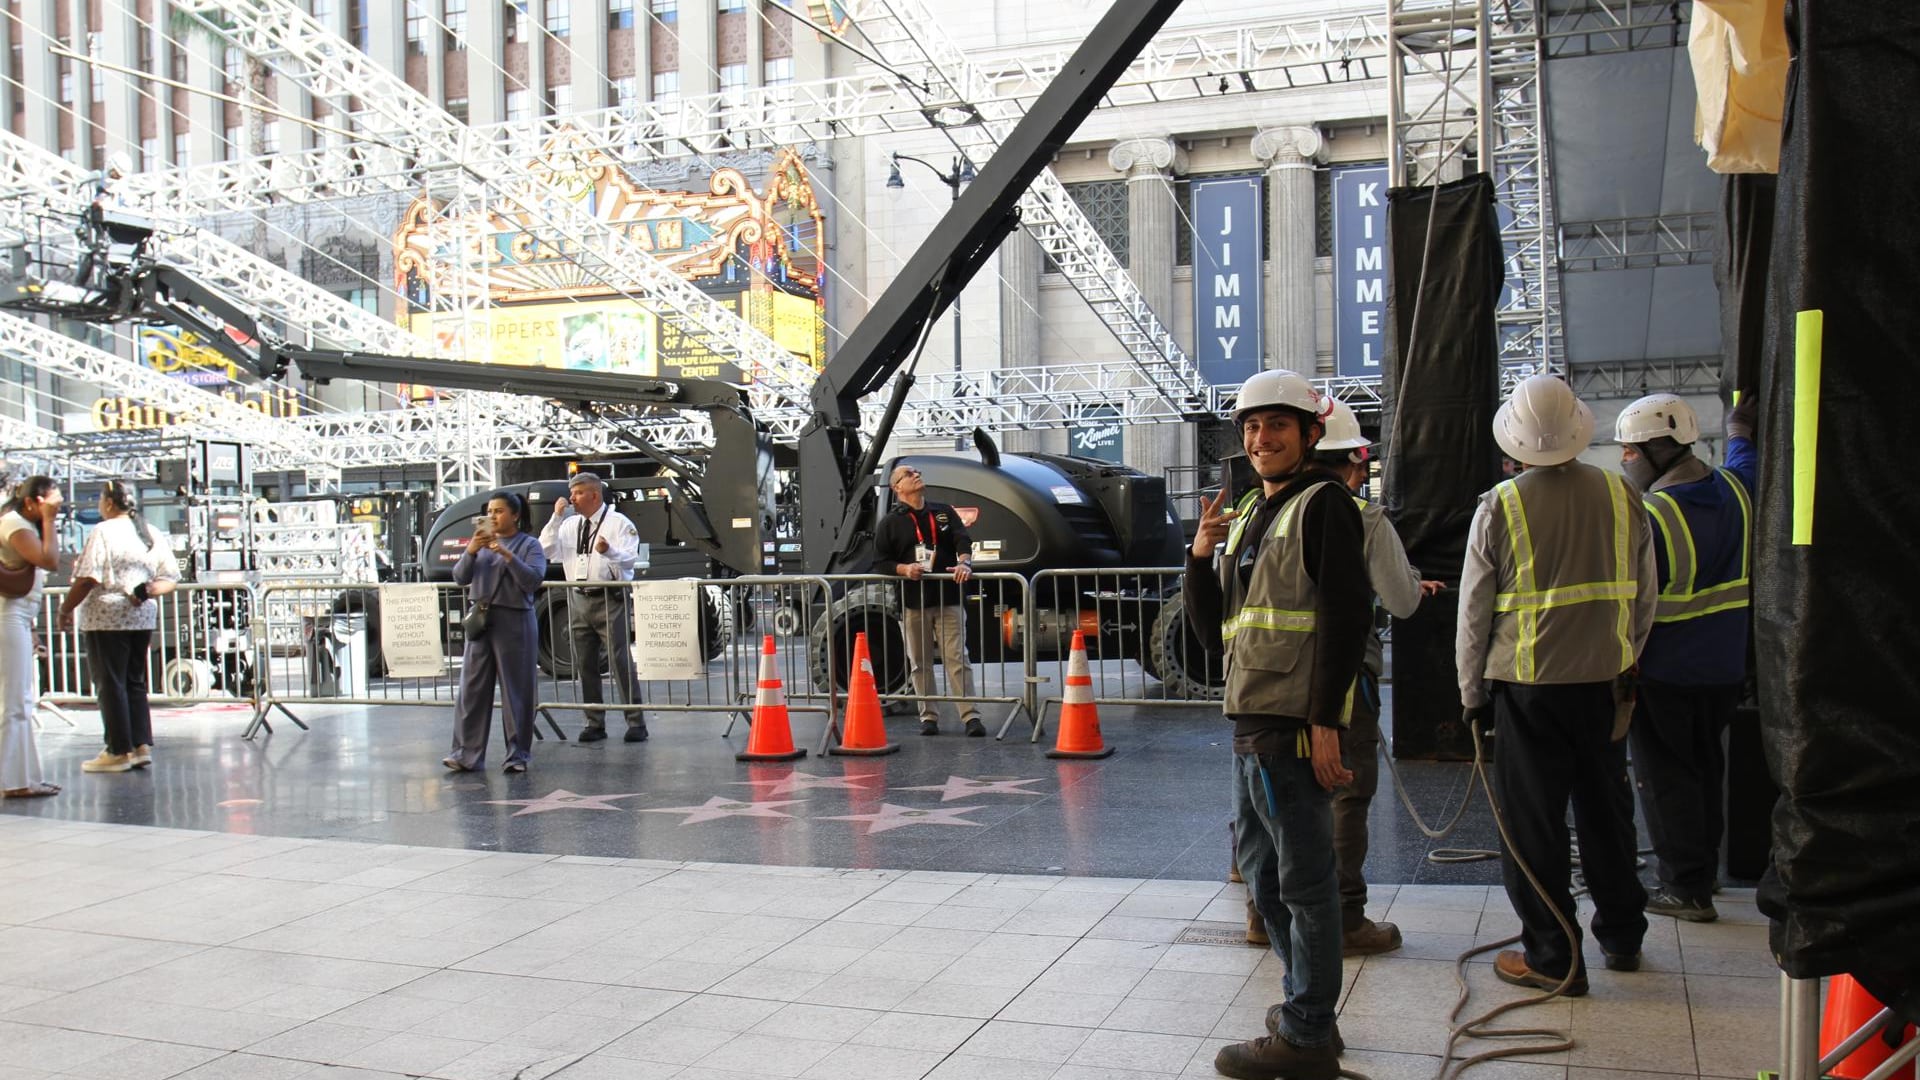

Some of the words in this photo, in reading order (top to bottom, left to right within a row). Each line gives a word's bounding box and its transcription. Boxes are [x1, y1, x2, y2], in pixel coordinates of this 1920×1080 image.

[1355, 182, 1383, 367] KIMMEL
[1214, 206, 1240, 360] JIMMY
[680, 366, 719, 379] CENTER!
[1073, 426, 1121, 449] Kimmel
[400, 595, 434, 604] PROPERTY
[654, 594, 692, 602] PROPERTY
[397, 605, 422, 613] CLOSED
[397, 614, 409, 622] THE
[410, 613, 433, 621] PUBLIC
[396, 631, 424, 639] WITHOUT
[650, 631, 681, 639] WITHOUT
[392, 640, 431, 648] PERMISSION
[645, 640, 688, 648] PERMISSION
